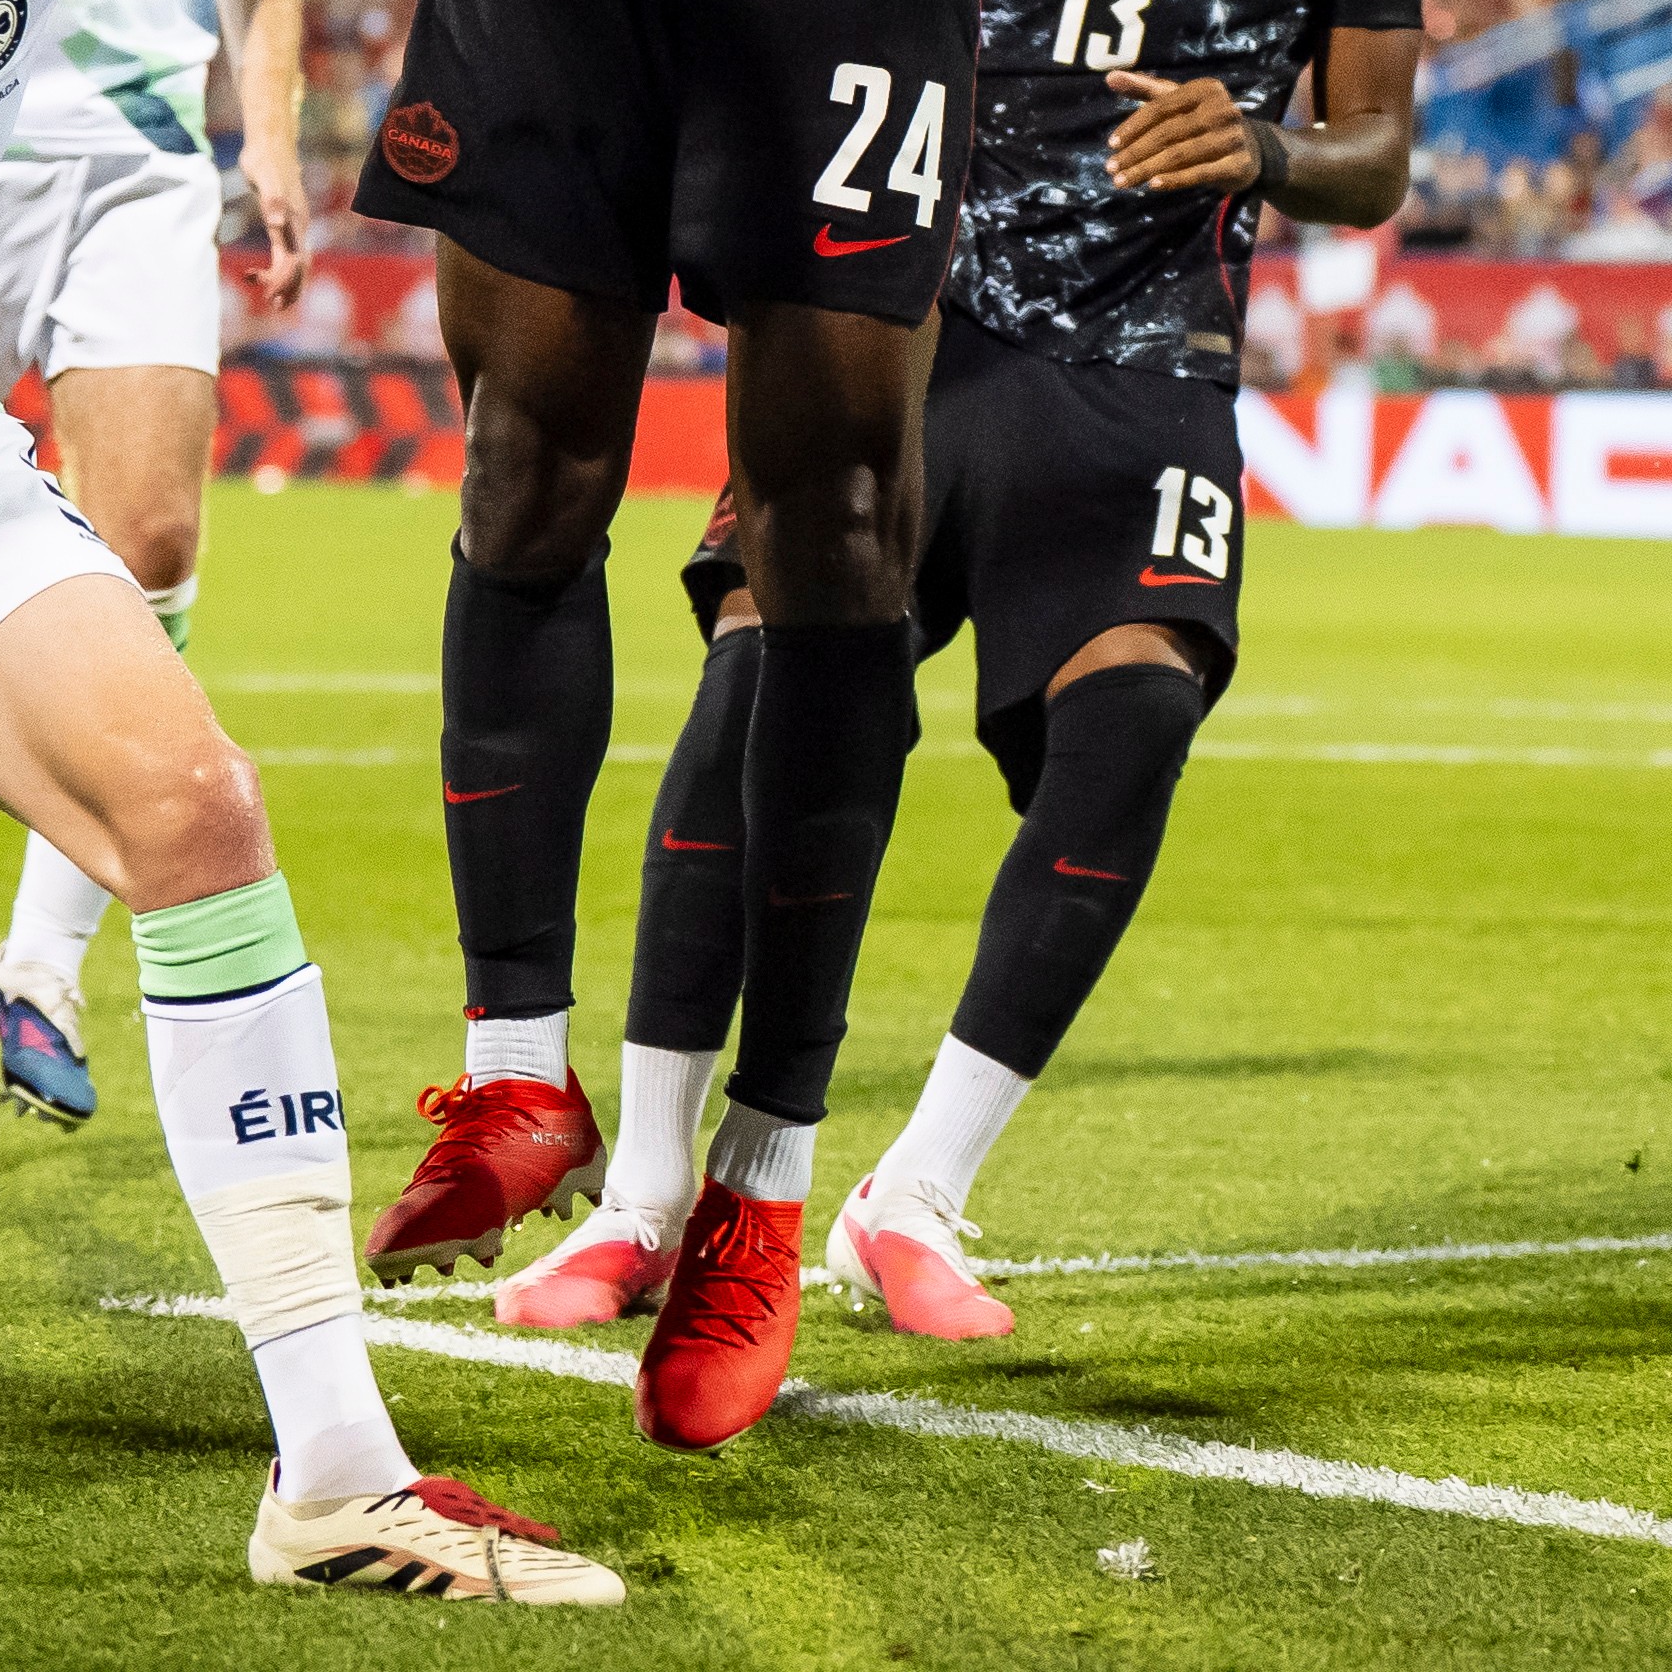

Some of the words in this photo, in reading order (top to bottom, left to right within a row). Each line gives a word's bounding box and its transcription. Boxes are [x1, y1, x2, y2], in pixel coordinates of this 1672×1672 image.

[388, 129, 453, 160] CANADA
[813, 62, 946, 228] 24
[1151, 466, 1233, 579] 13
